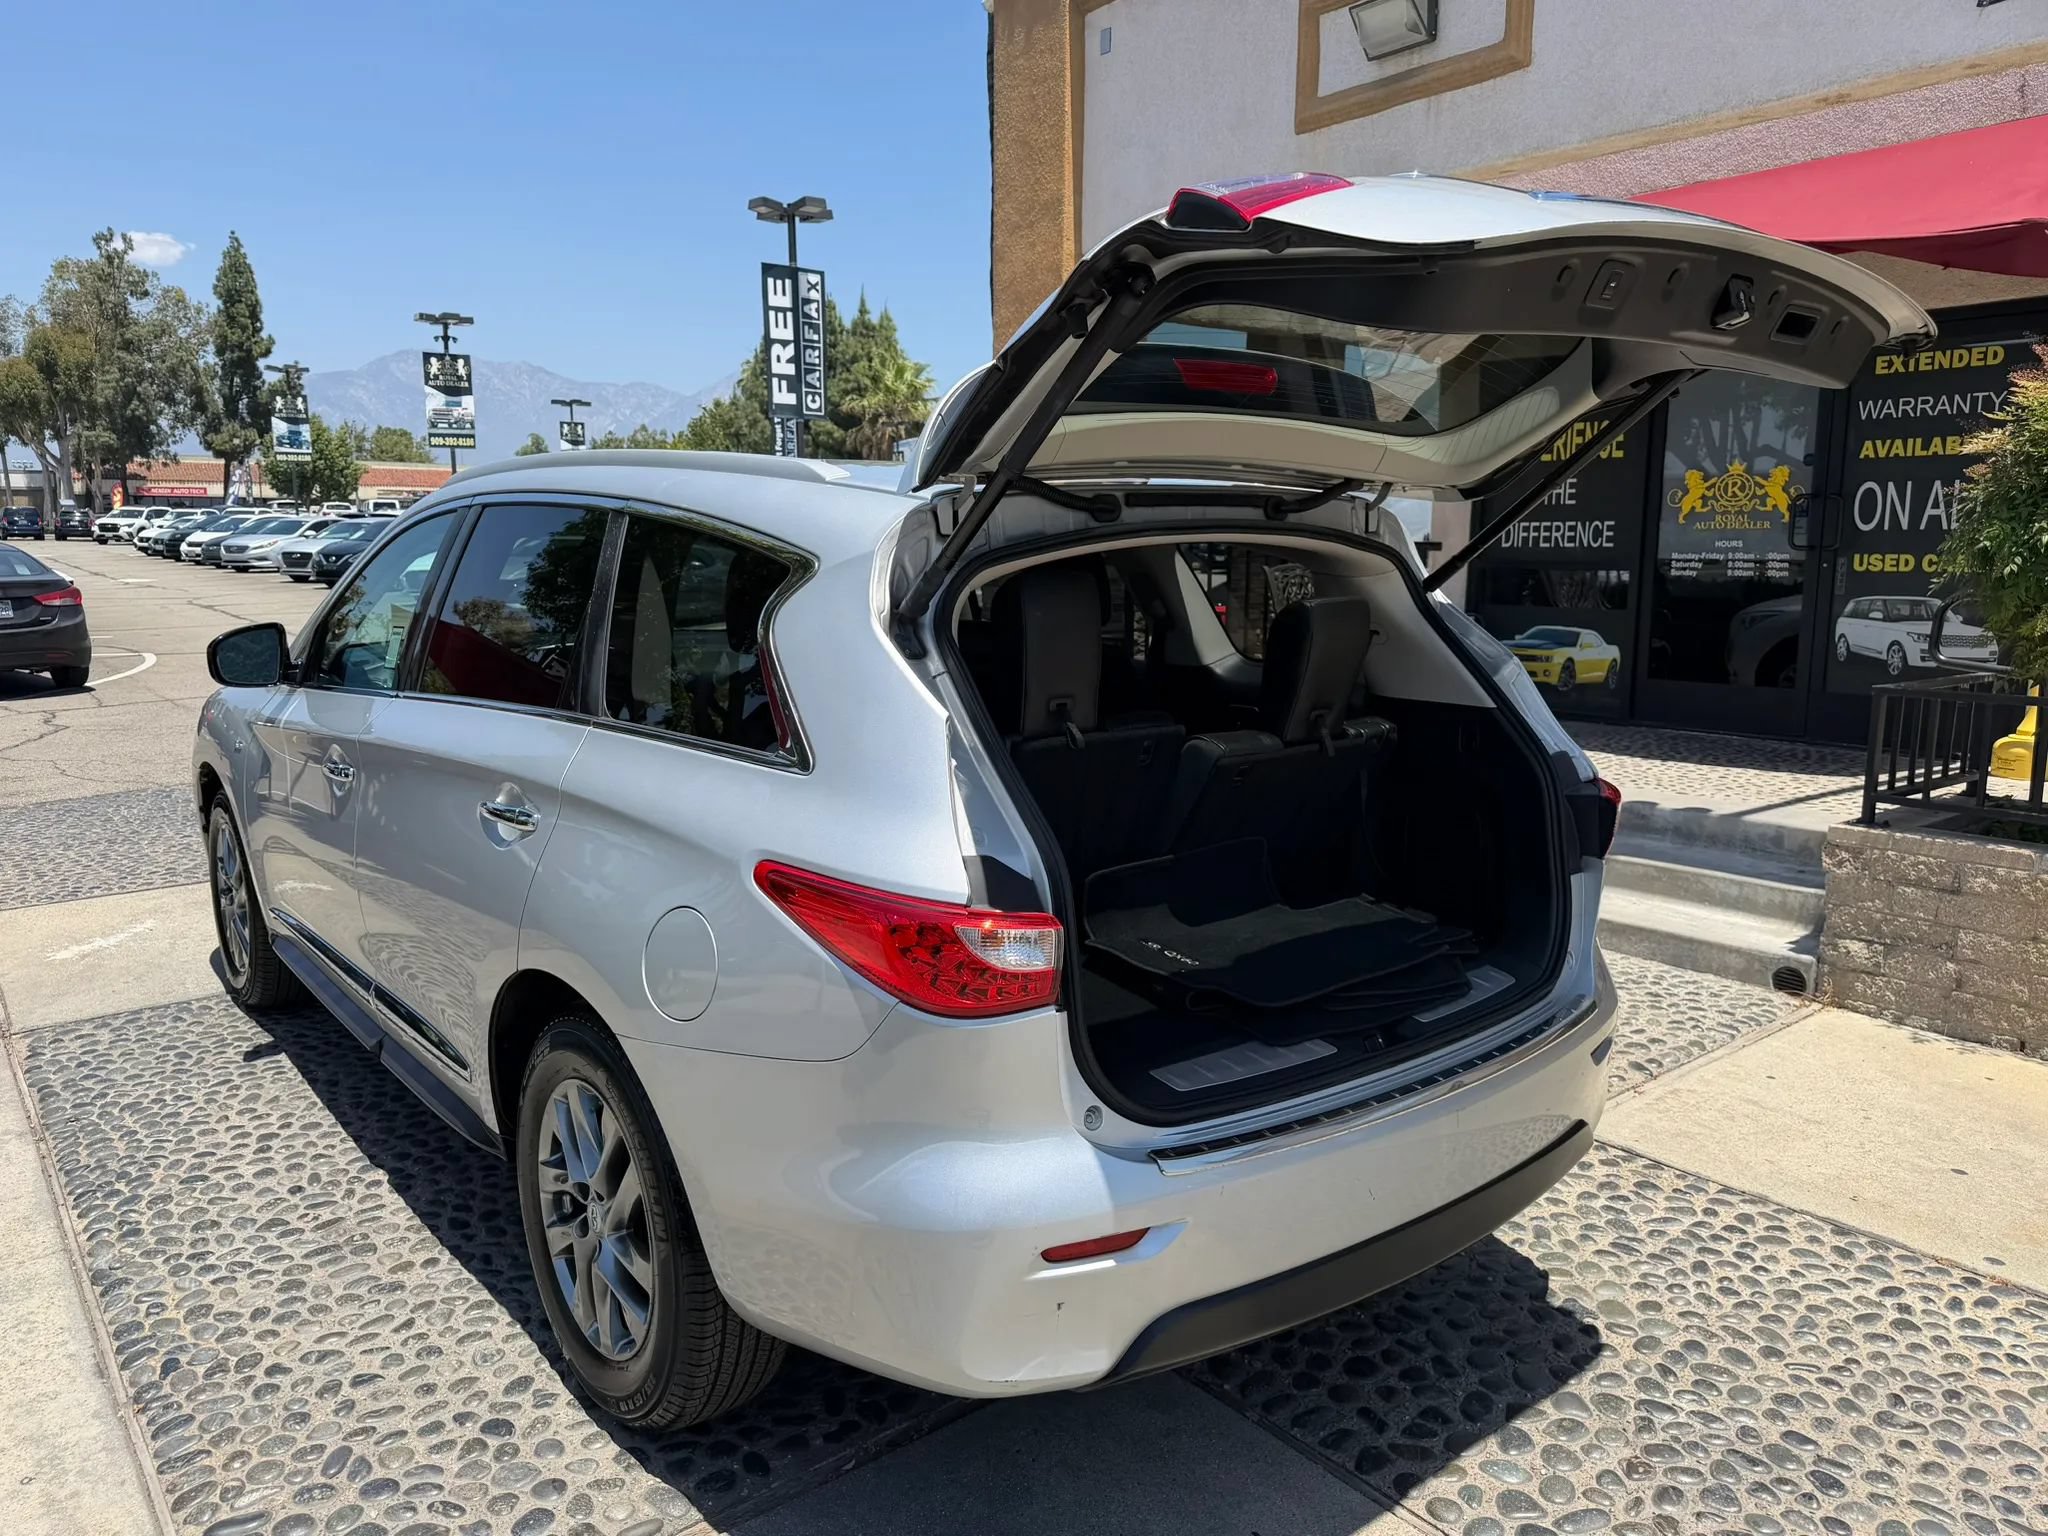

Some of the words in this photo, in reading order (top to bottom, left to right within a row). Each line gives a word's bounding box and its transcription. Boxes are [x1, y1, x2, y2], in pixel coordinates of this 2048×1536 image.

[767, 277, 797, 405] FREE
[803, 279, 822, 410] CARFAX
[1875, 346, 2004, 375] EXTENDED
[1858, 390, 2009, 420] WARRANTY
[1859, 435, 1963, 459] AVAILAB
[1854, 480, 1912, 531] ON
[1694, 521, 1725, 529] AUTO
[1727, 521, 1771, 529] DEALER
[1715, 514, 1750, 522] ROYAL
[1501, 521, 1616, 548] DIFFERENCE
[1714, 540, 1743, 548] HOURS
[1670, 561, 1703, 569] Saturday
[1671, 552, 1724, 560] Monday-Friday
[1853, 554, 1915, 572] USED
[1670, 569, 1697, 577] Sunday
